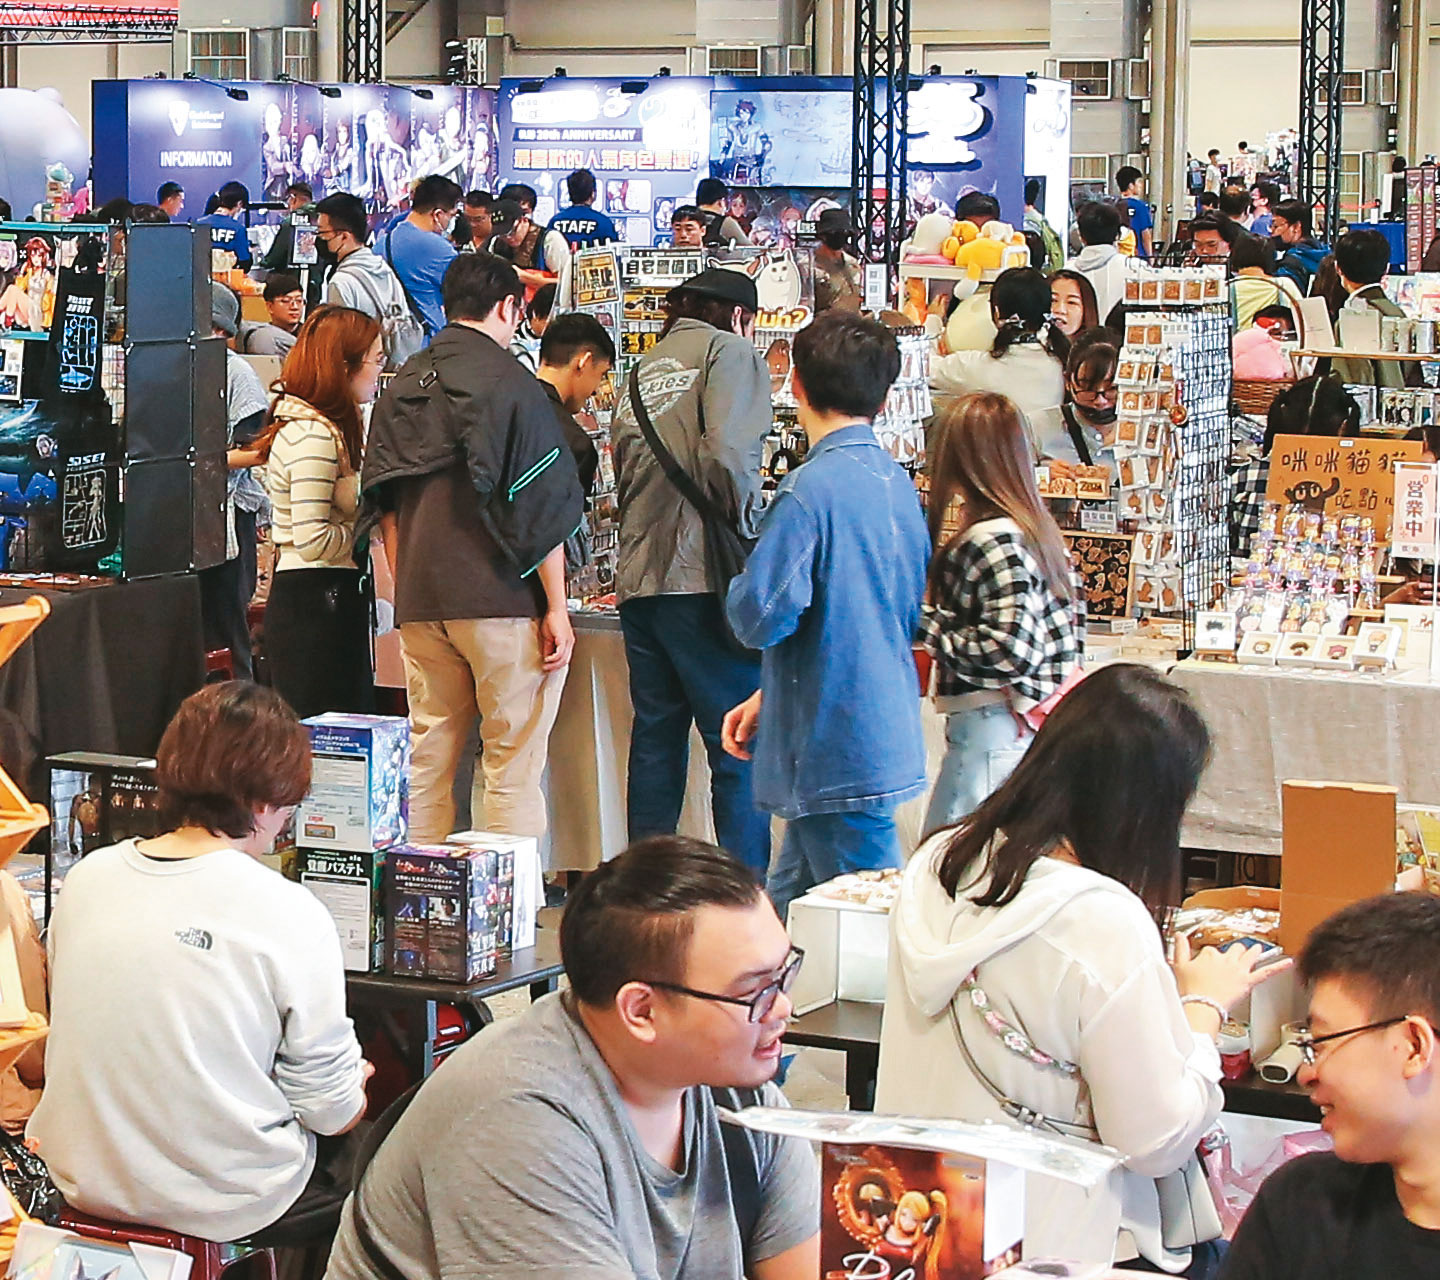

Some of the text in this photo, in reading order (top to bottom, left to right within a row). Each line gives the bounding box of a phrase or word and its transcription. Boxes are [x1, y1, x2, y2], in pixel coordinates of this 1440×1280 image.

[562, 129, 637, 141] ANNIVERSARY
[160, 150, 233, 167] INFORMATION
[553, 220, 597, 234] STAFF
